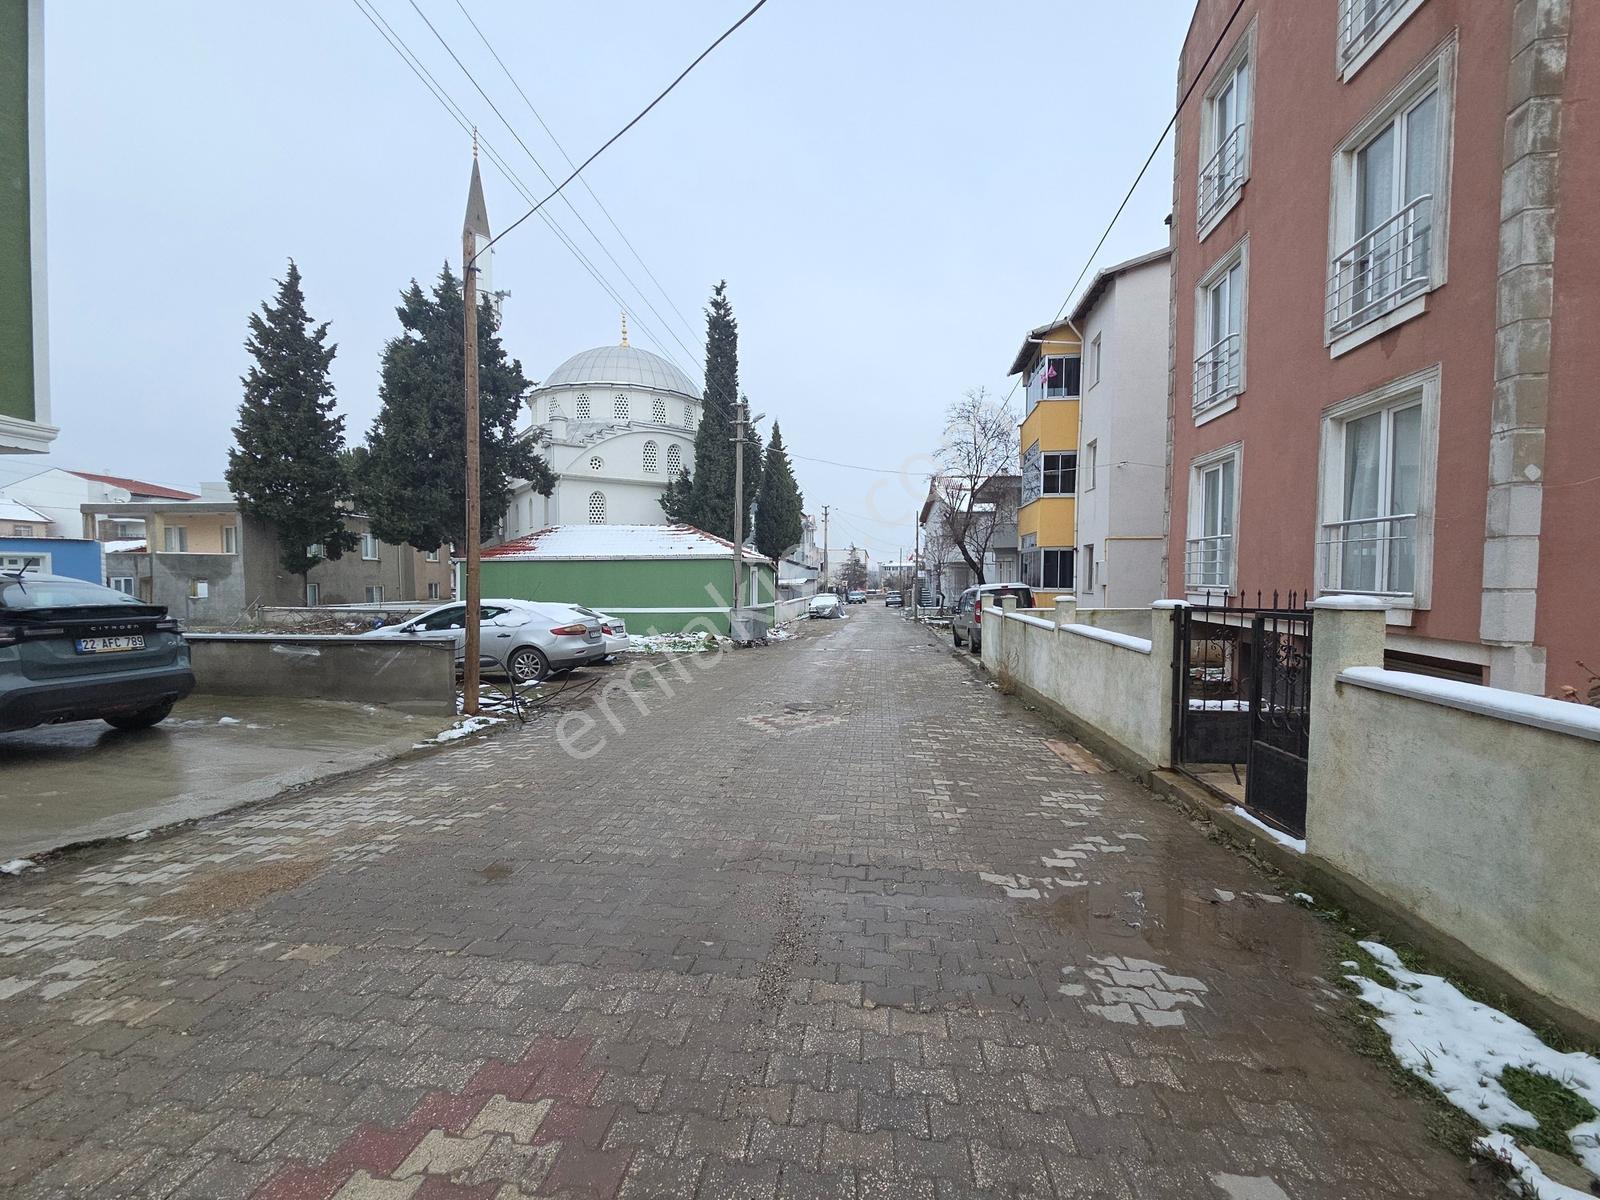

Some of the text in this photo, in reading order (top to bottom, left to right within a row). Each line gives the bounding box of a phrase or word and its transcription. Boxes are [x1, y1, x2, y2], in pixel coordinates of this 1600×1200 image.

[82, 636, 144, 650] 22 AFC 789
